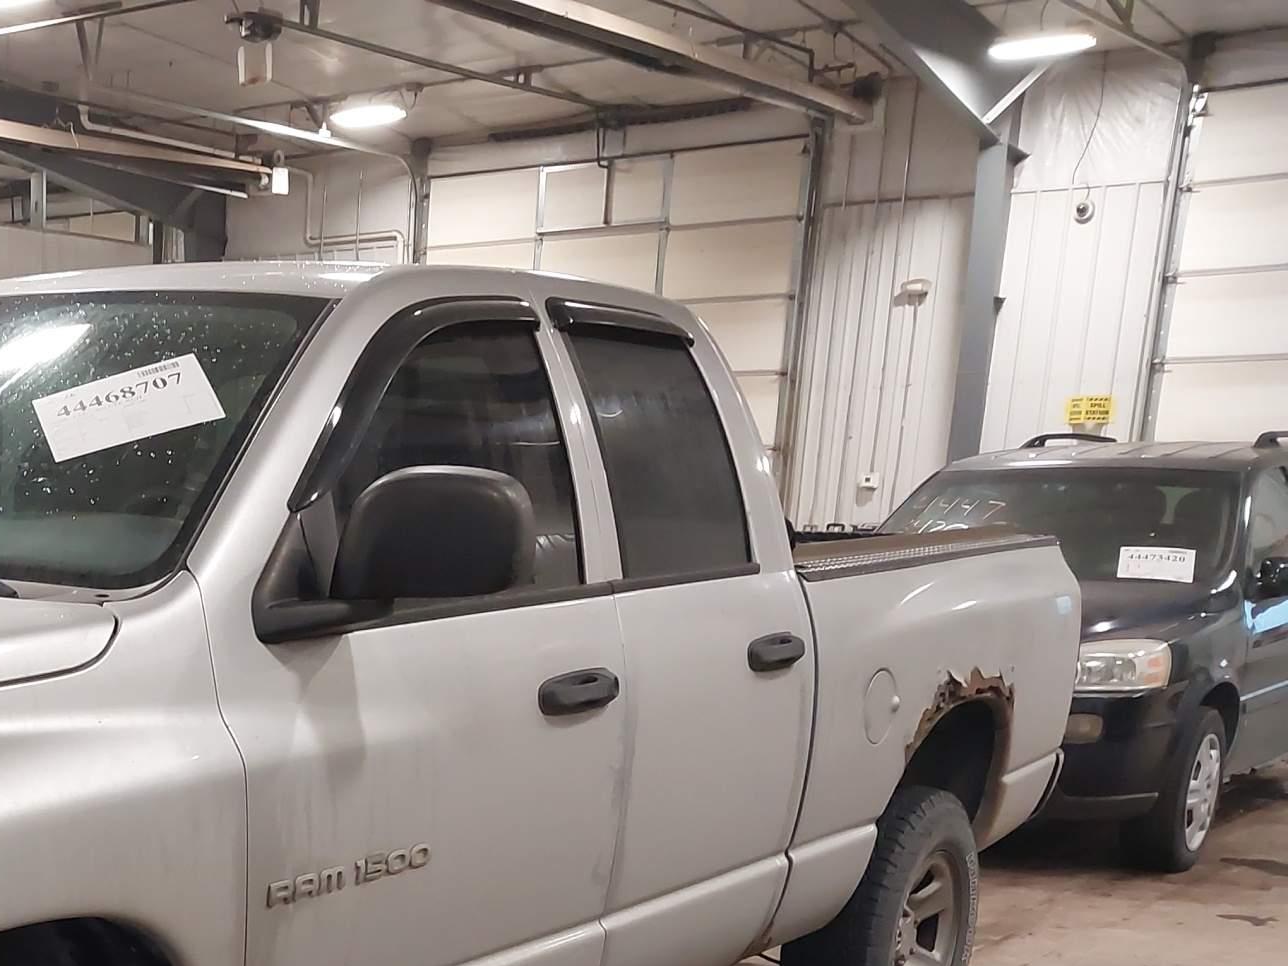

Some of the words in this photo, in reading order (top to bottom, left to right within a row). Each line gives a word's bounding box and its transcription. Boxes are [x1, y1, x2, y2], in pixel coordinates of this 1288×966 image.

[57, 372, 183, 418] 44468707
[266, 865, 346, 909] RAM
[354, 842, 432, 886] 1500
